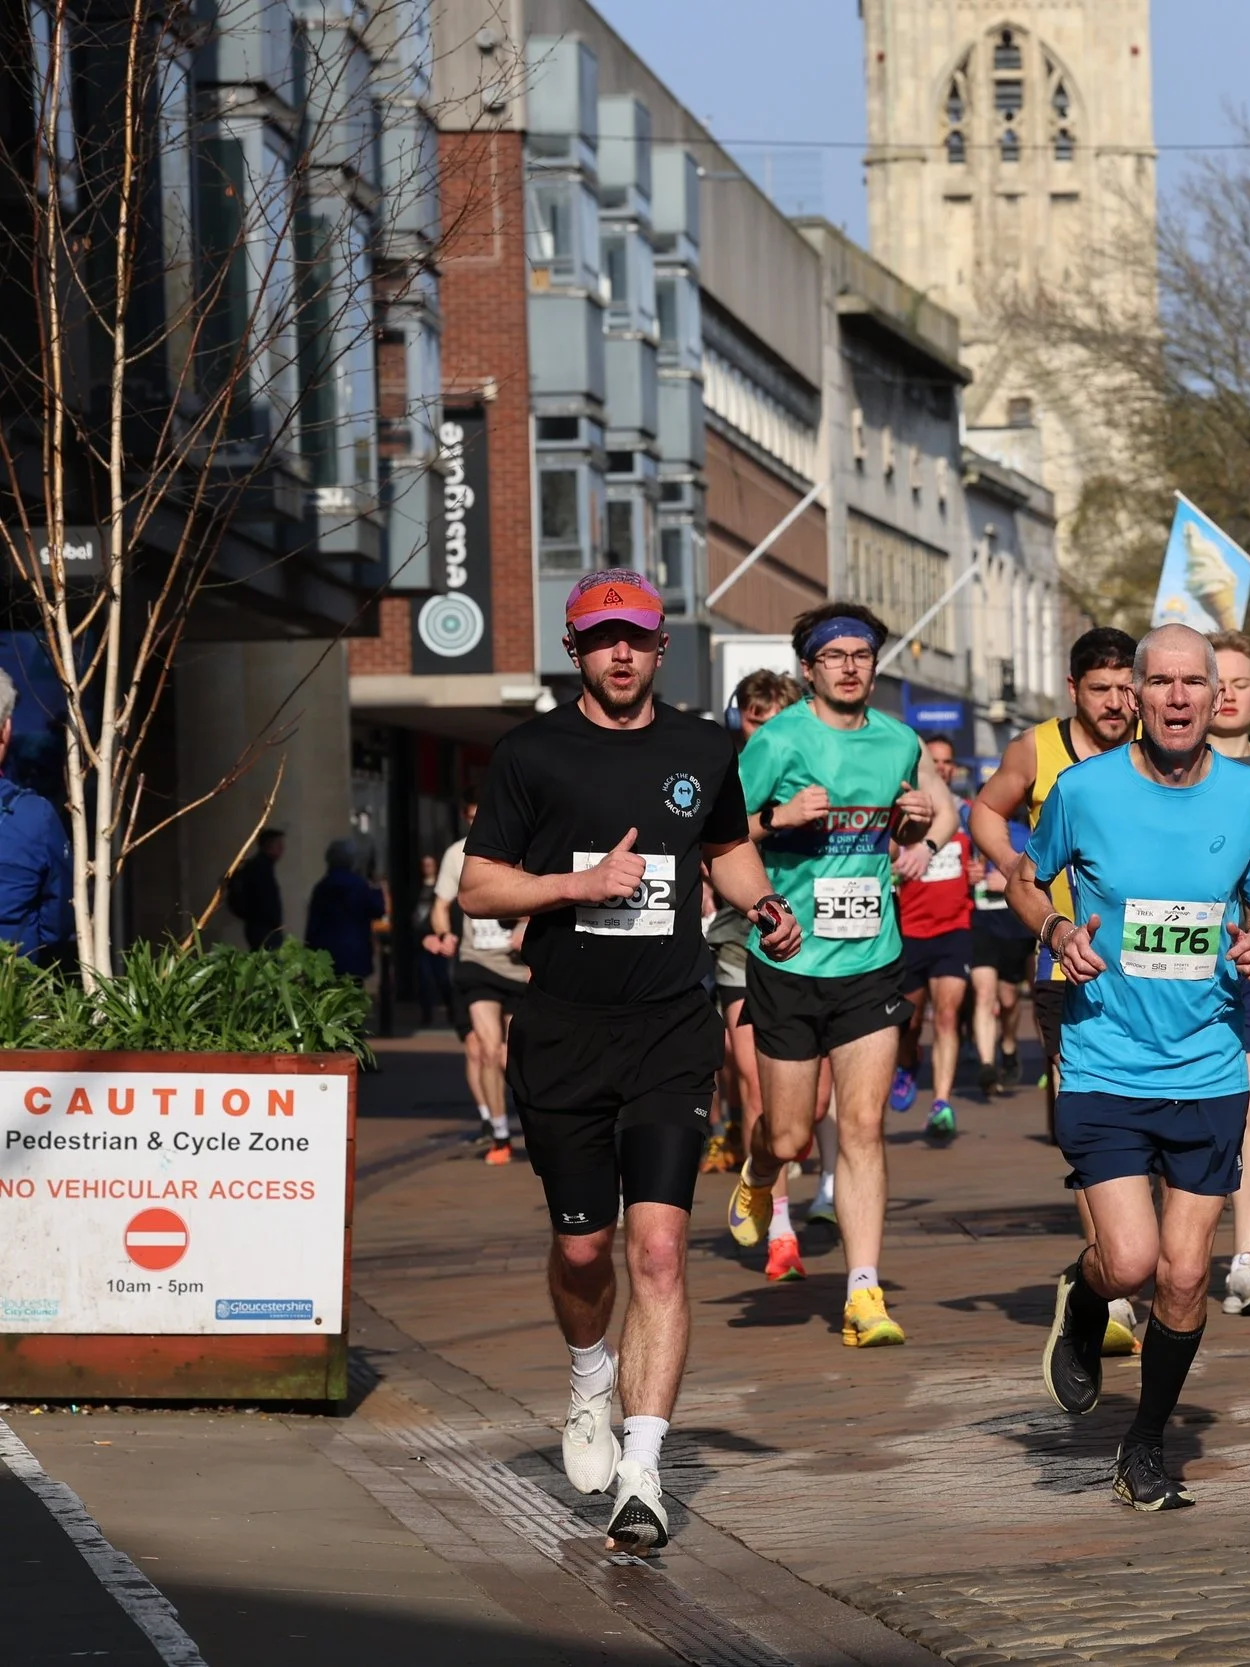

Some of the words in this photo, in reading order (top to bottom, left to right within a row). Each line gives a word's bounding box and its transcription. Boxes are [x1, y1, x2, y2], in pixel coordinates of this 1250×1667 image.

[816, 896, 880, 919] 3462
[1133, 925, 1210, 955] 1176
[23, 1086, 296, 1117] CAUTION
[5, 1130, 138, 1151] Pedestrian
[146, 1131, 164, 1151] &
[173, 1131, 241, 1156] Cycle
[248, 1131, 310, 1152] Zone
[0, 1179, 36, 1199] NO
[47, 1179, 199, 1200] VEHICULAR
[208, 1180, 316, 1200] ACCESS
[106, 1279, 151, 1293] 10am
[167, 1279, 205, 1294] 5pm
[230, 1301, 312, 1315] Gloucestershire
